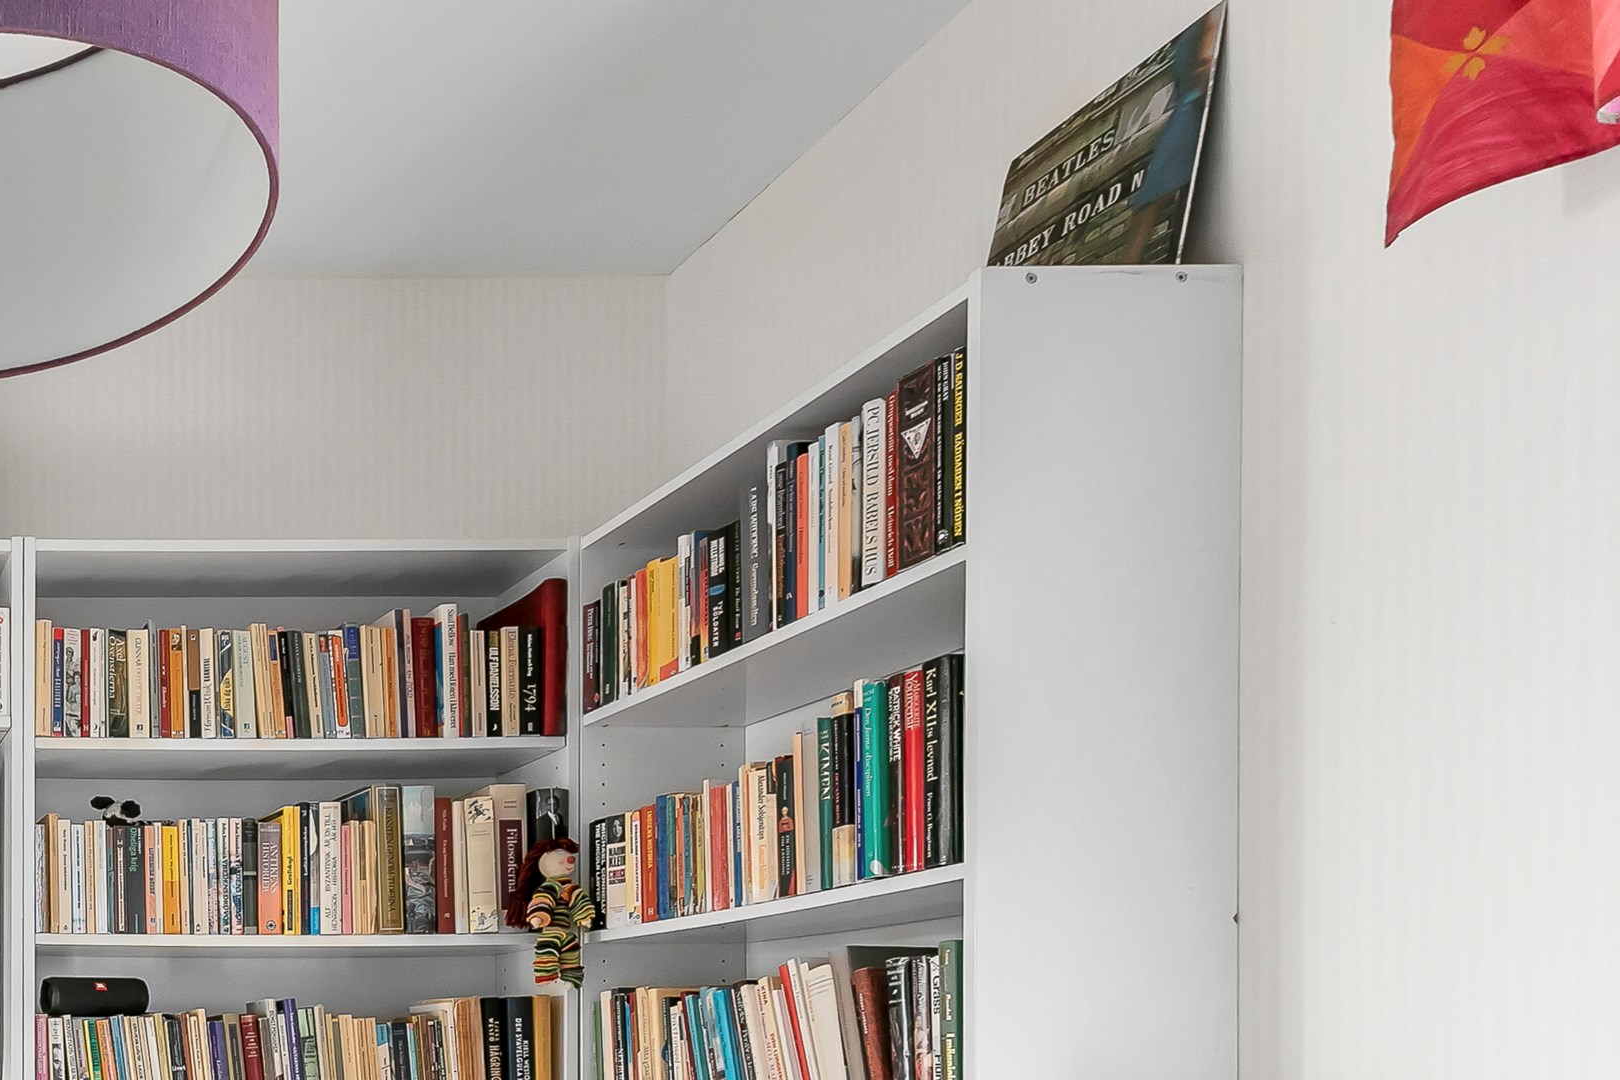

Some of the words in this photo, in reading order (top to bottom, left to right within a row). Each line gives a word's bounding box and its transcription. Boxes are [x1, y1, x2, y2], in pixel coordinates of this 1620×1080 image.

[1022, 128, 1116, 208] BEATLES
[995, 225, 1056, 267] BBEY
[1061, 182, 1122, 236] ROAD
[866, 430, 880, 486] JERSILD
[953, 431, 965, 490] RÄDDAREN
[953, 498, 964, 538] NÖDEN
[866, 550, 878, 577] HUS
[116, 638, 126, 662] Axel
[135, 637, 143, 667] GUNNAR
[448, 624, 456, 646] Bellow
[507, 630, 517, 657] Elena
[108, 635, 118, 699] Oxenstierna
[449, 652, 457, 666] Han
[489, 647, 499, 662] ULF
[449, 666, 457, 682] med
[489, 662, 500, 711] DANIELSSON
[508, 659, 517, 699] Ferrante
[926, 668, 937, 697] Karl
[523, 683, 537, 712] 1794
[891, 686, 901, 728] PATRICK
[905, 674, 919, 731] Yourcenar
[913, 683, 921, 728] MARGUERITE
[926, 700, 937, 738] XII:s
[892, 728, 901, 760] WHITE
[926, 741, 937, 782] levnad
[820, 742, 831, 801] KIMEN
[129, 827, 138, 856] Oheliga
[384, 807, 395, 844] KONSTEN
[129, 857, 139, 872] krig
[261, 842, 270, 893] HISTORIER
[270, 842, 279, 893] ANTIKENS
[386, 845, 396, 876] GENOM
[506, 828, 519, 893] Filosoferna
[387, 877, 398, 912] TIDERNA
[515, 1033, 524, 1077] SVAVELGULA
[523, 1059, 531, 1080] WESTÖ
